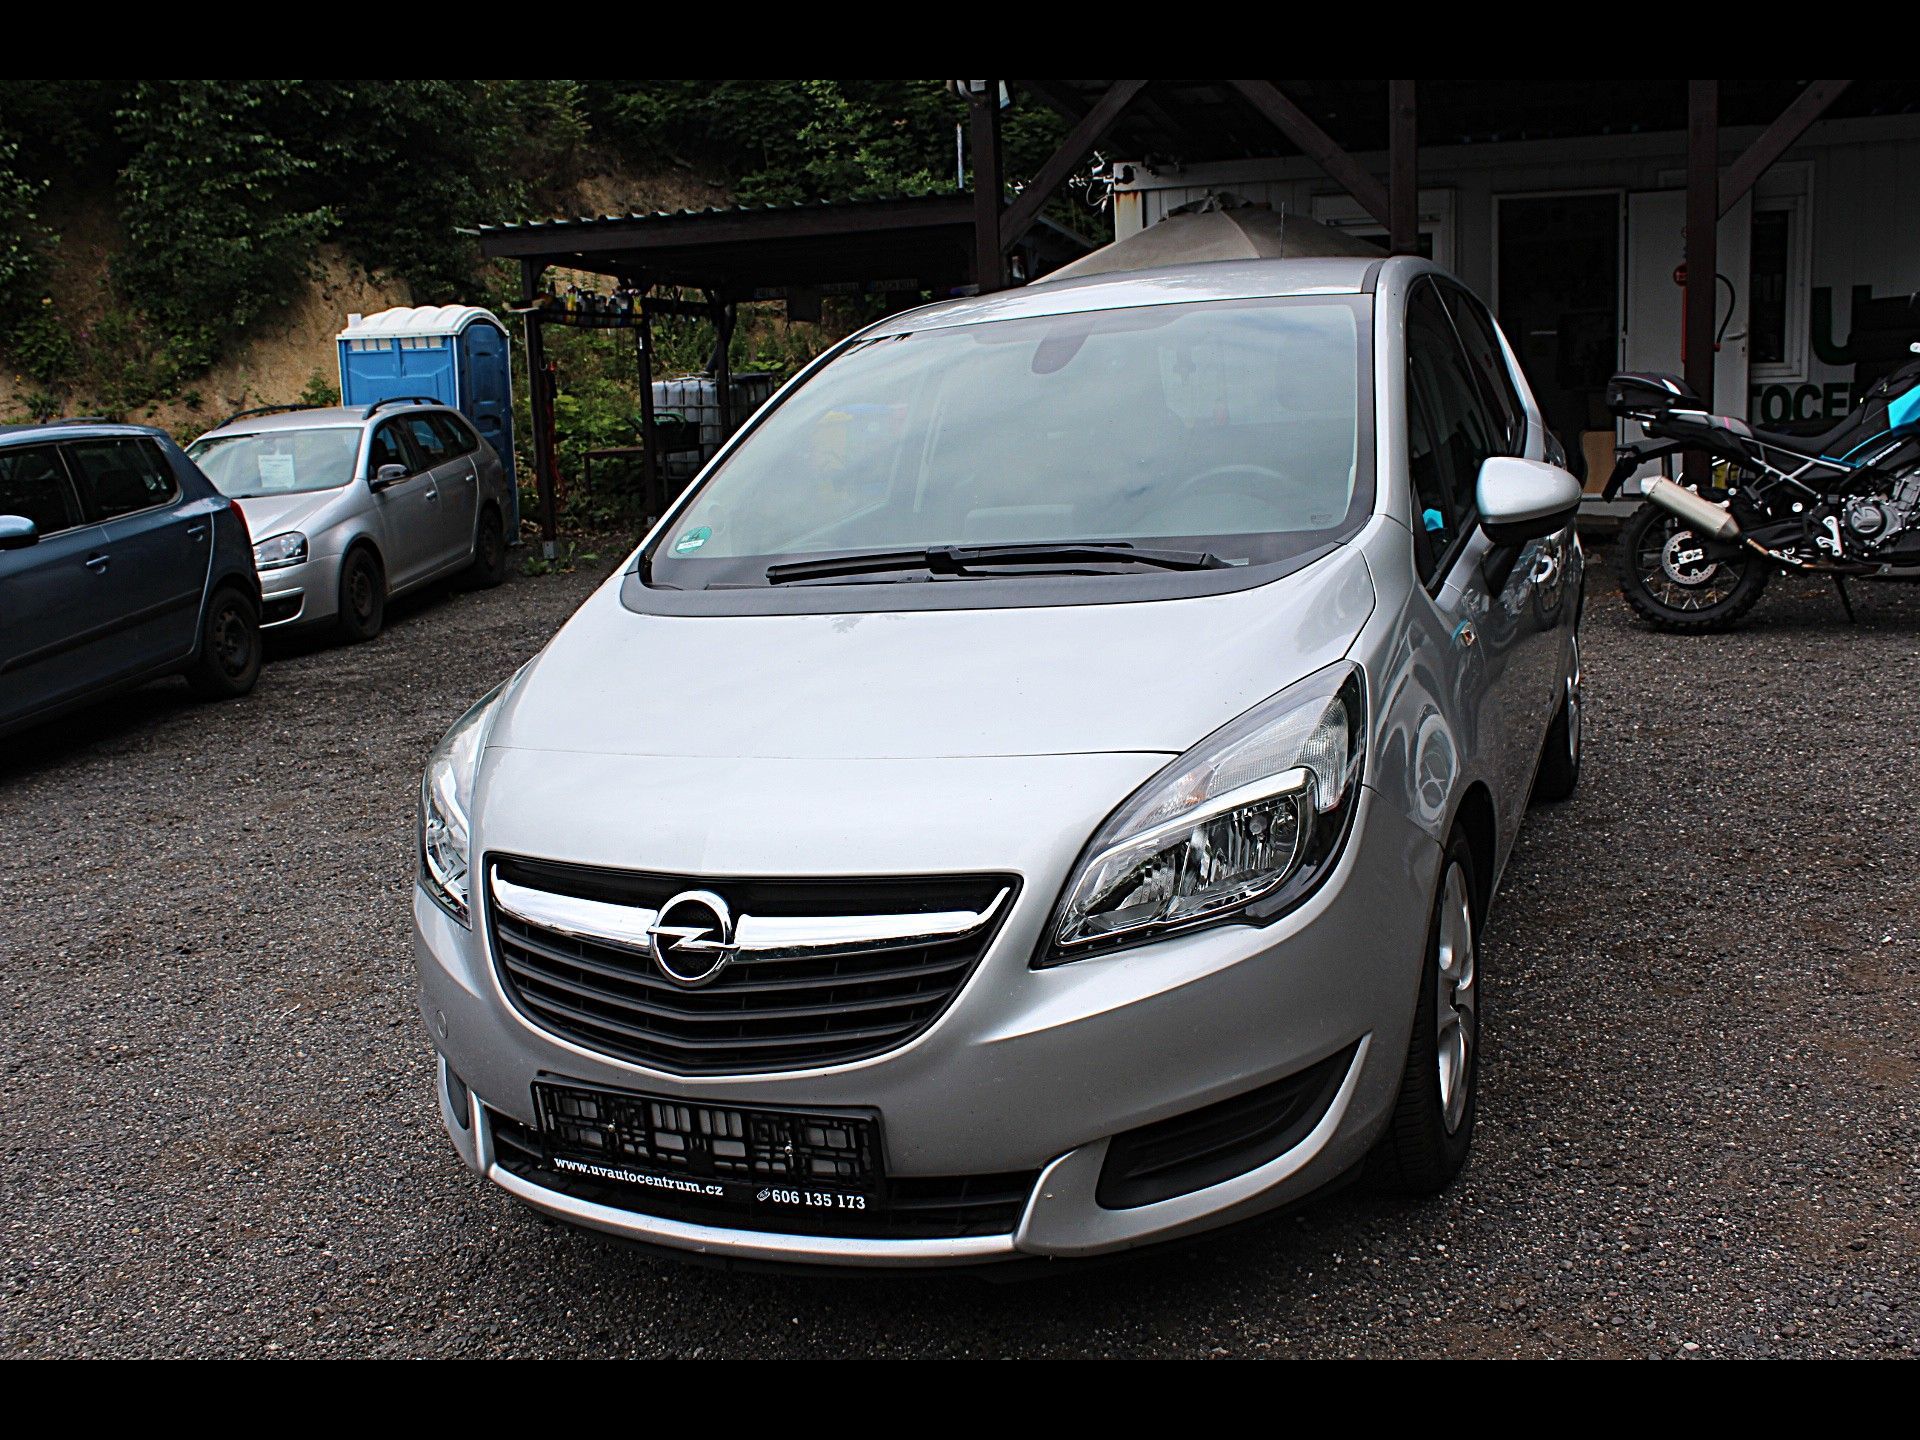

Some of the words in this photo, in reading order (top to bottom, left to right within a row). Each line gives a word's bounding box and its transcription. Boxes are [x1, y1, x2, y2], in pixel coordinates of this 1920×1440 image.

[1750, 383, 1857, 423] OCE
[553, 1157, 724, 1196] www.uvautocentrum.cz
[772, 1189, 800, 1204] 606
[804, 1192, 832, 1207] 135
[837, 1194, 866, 1209] 173
